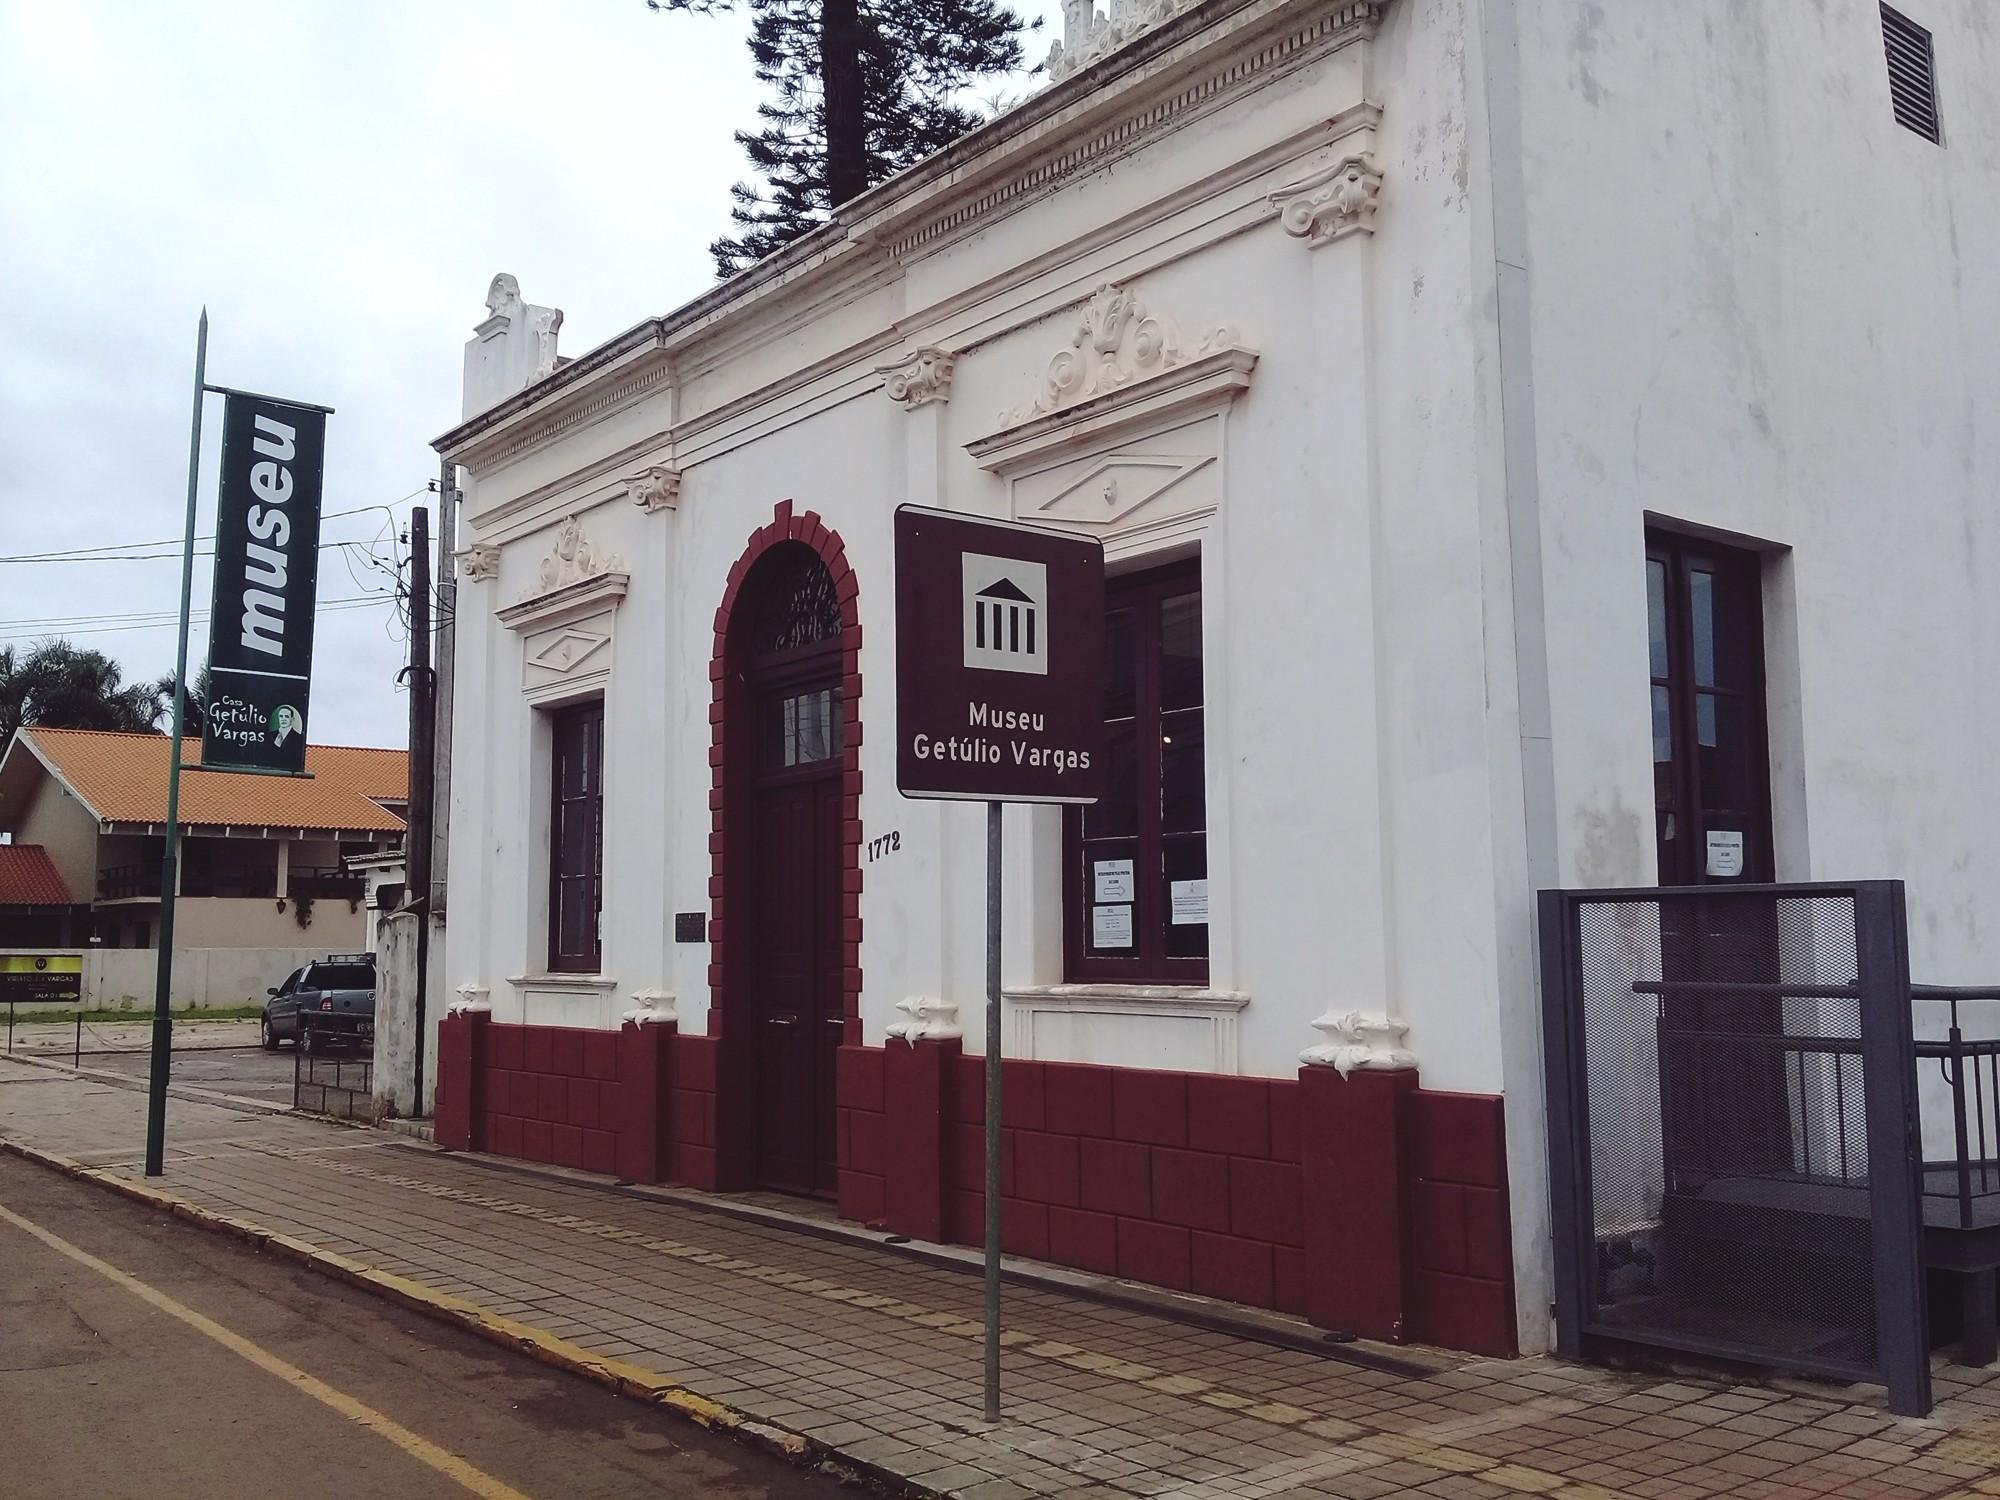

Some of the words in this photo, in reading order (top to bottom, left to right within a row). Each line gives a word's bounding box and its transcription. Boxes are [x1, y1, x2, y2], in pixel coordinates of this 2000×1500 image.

[241, 413, 297, 657] museu
[209, 702, 267, 724] Getúlio
[222, 695, 243, 706] Casa
[969, 702, 1044, 732] Museu
[212, 721, 265, 747] Vargas
[913, 733, 1001, 764] Getúlio
[1010, 740, 1091, 775] Vargas
[868, 830, 901, 863] 1772
